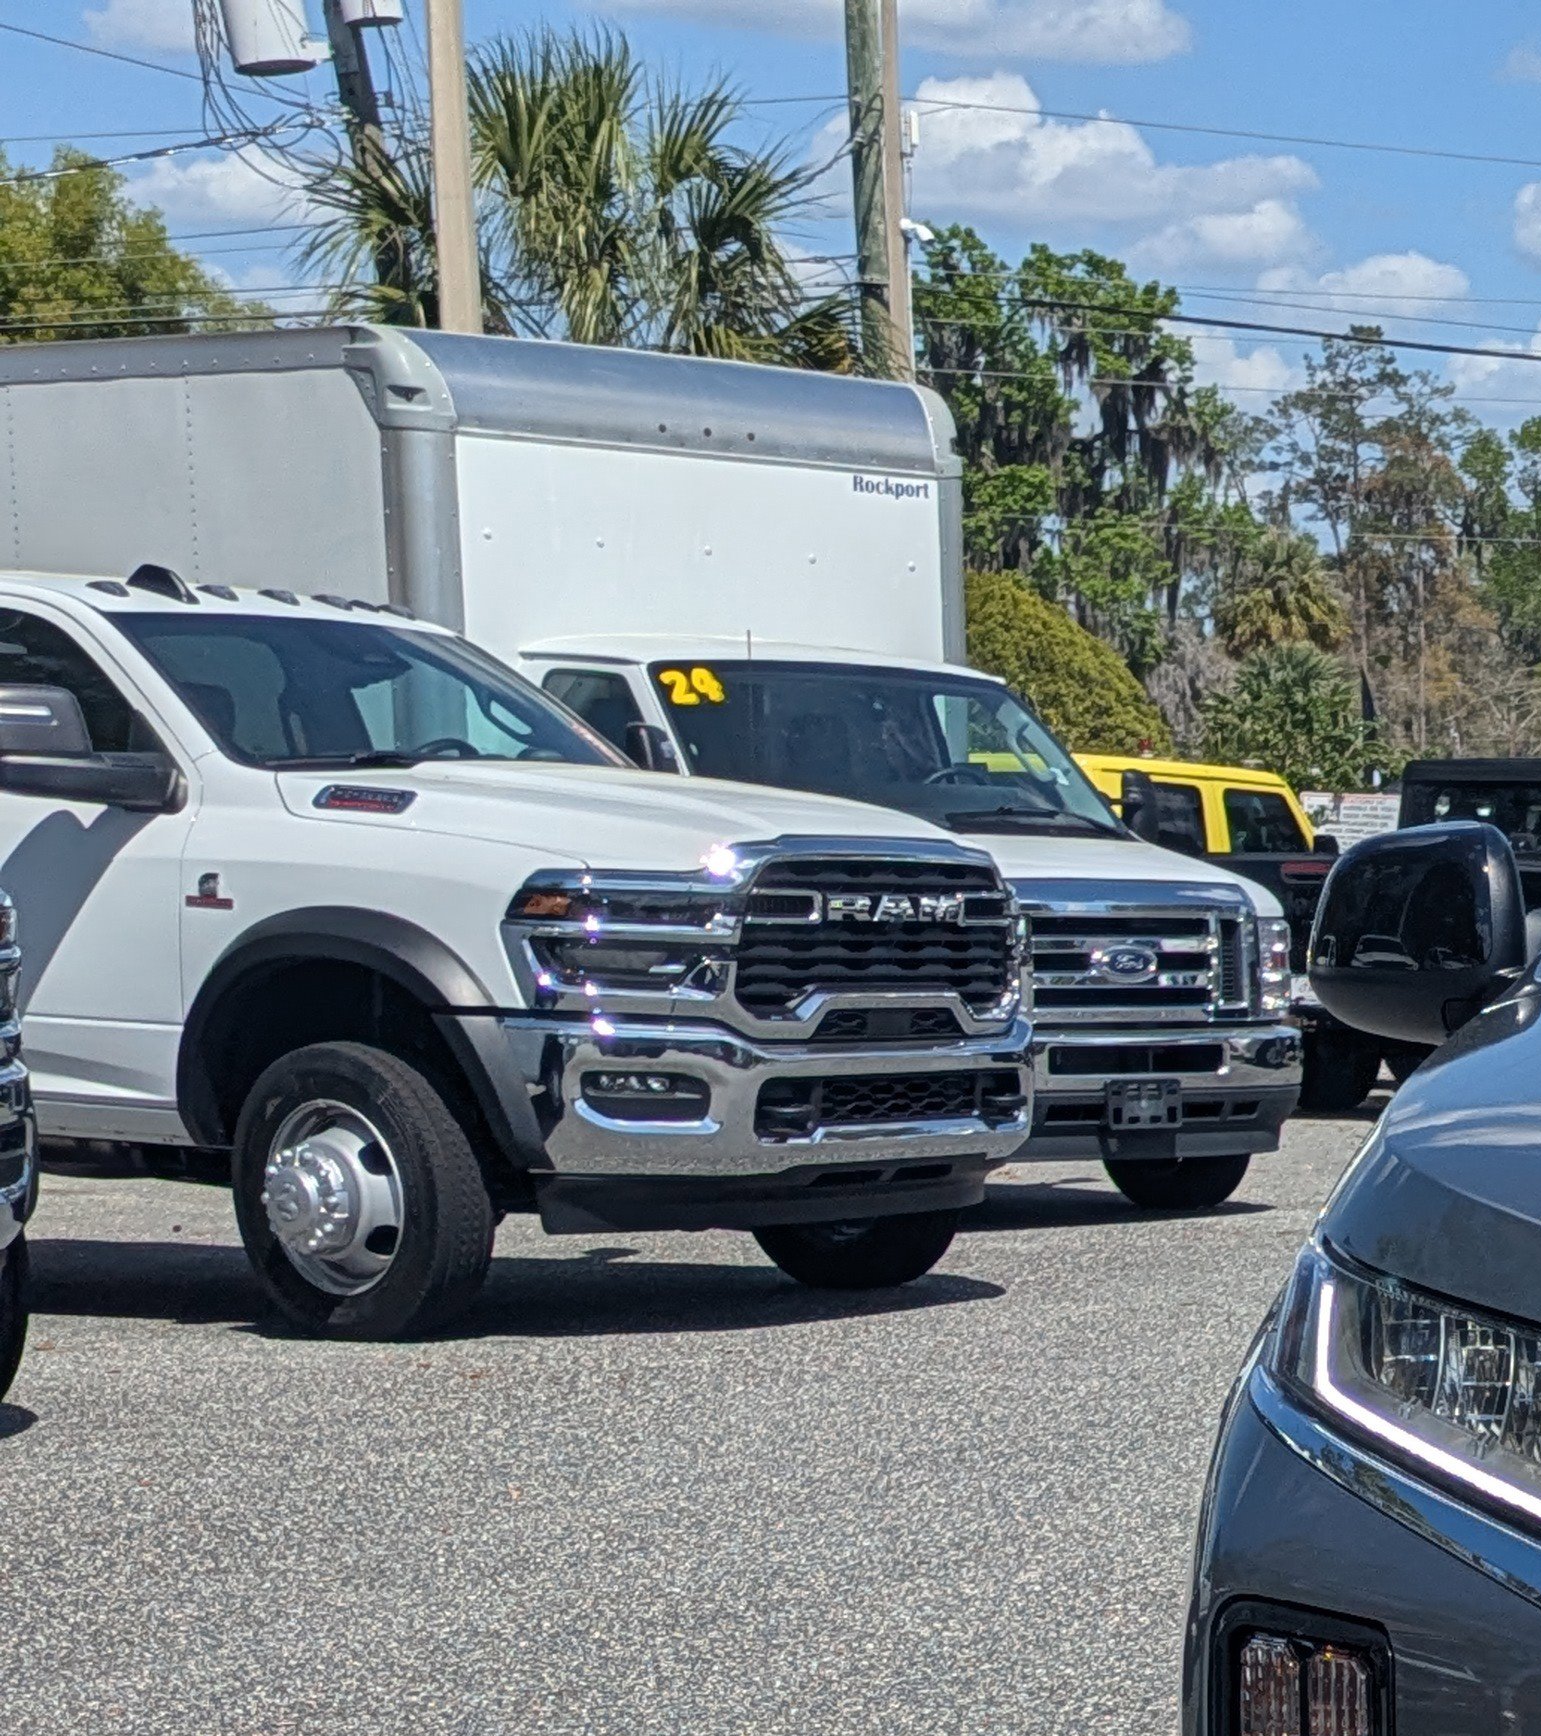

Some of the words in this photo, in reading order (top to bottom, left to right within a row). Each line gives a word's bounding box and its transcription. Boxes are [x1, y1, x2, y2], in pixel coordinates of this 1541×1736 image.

[853, 474, 930, 500] Rockport
[658, 667, 726, 706] 24
[827, 893, 961, 922] RAM
